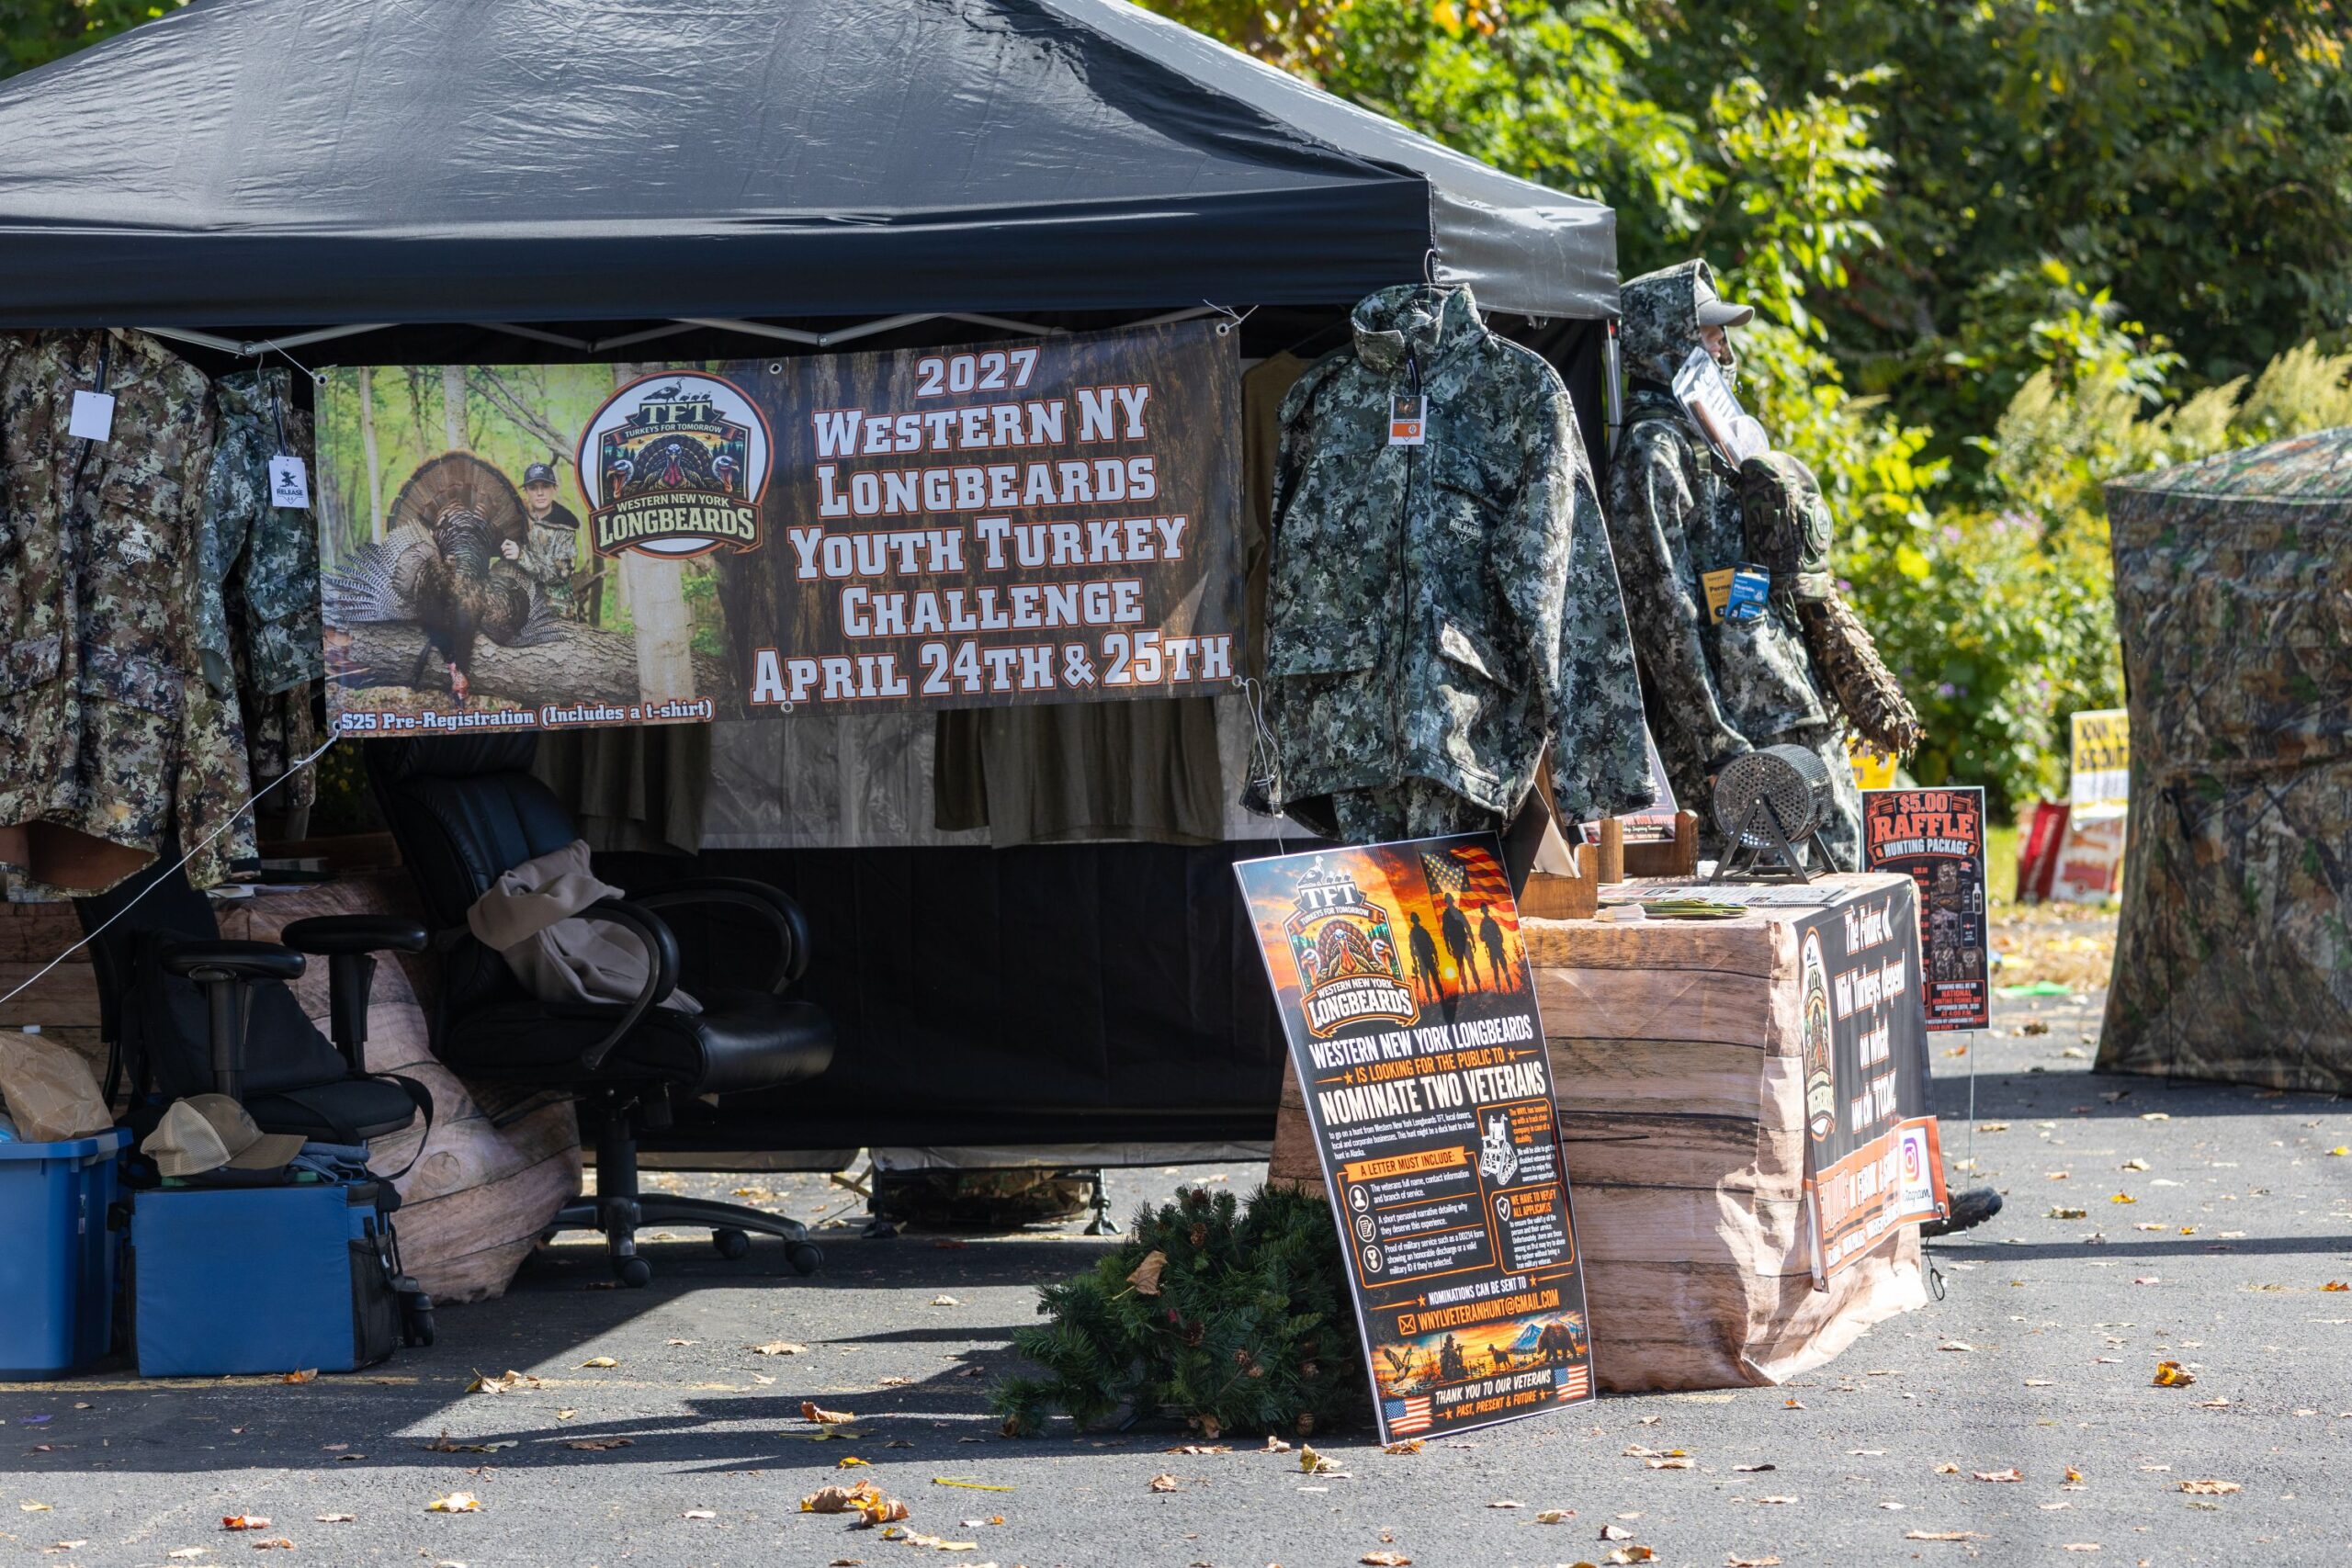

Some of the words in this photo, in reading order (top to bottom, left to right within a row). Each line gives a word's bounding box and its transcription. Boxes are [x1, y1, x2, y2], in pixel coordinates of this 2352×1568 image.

[917, 348, 1038, 396] 2027
[641, 401, 711, 424] TFT
[1078, 386, 1151, 443] NY
[625, 425, 660, 438] TURKEYS
[661, 423, 675, 432] FOR
[678, 423, 723, 434] TOMORROW
[277, 488, 304, 496] RELEASE
[616, 494, 669, 513] WESTERN
[671, 493, 696, 504] NEW
[699, 493, 730, 508] YORK
[598, 507, 755, 547] LONGBEARDS
[1449, 519, 1482, 537] RELEASE
[1063, 643, 1095, 687] &
[341, 712, 377, 731] $25
[382, 709, 535, 731] Pre-Registration
[541, 704, 625, 727] (Includes
[630, 707, 641, 719] a
[646, 698, 713, 722] t-shirt)
[1899, 793, 1948, 814] $5.00
[1873, 813, 1974, 843] RAFFLE
[1883, 839, 1925, 858] HUNTING
[1927, 839, 1968, 855] PACKAGE
[1301, 885, 1356, 909] TFT
[1301, 908, 1324, 925] TURKEYS
[1324, 907, 1335, 917] FOR
[1335, 906, 1370, 918] TOMORROW
[1316, 980, 1352, 999] WESTERN
[1351, 978, 1371, 989] NEW
[1370, 978, 1394, 989] YORK
[1307, 988, 1414, 1028] LONGBEARDS
[1308, 1035, 1379, 1069] WESTERN
[1378, 1030, 1413, 1059] NEW
[1413, 1024, 1453, 1054] YORK
[1452, 1014, 1533, 1049] LONGBEARDS
[1354, 1066, 1368, 1084] IS
[1369, 1059, 1414, 1082] LOOKING
[1414, 1057, 1436, 1075] FOR
[1435, 1054, 1456, 1071] THE
[1456, 1048, 1492, 1068] PUBLIC
[1491, 1047, 1506, 1064] TO
[1317, 1078, 1422, 1126] NOMINATE
[1419, 1072, 1464, 1111] TWO
[1463, 1061, 1546, 1104] VETERANS
[1329, 1132, 1335, 1140] to
[1335, 1132, 1341, 1140] go
[1351, 1127, 1363, 1135] hunt
[1363, 1125, 1374, 1134] from
[1374, 1123, 1393, 1132] Western
[1392, 1121, 1403, 1129] New
[1402, 1119, 1413, 1128] York
[1412, 1115, 1437, 1127] Longbeards
[1445, 1111, 1456, 1121] local
[1333, 1151, 1345, 1160] hunt
[1344, 1150, 1350, 1158] in
[1360, 1165, 1367, 1177] A
[1367, 1161, 1396, 1177] LETTER
[1397, 1156, 1419, 1170] MUST
[1420, 1151, 1456, 1168] INCLUDE:
[1370, 1183, 1381, 1192] The
[1381, 1180, 1402, 1191] veterans
[1401, 1179, 1410, 1188] full
[1410, 1179, 1425, 1187] name,
[1425, 1174, 1443, 1184] contact
[1442, 1169, 1470, 1181] information
[1374, 1194, 1384, 1204] and
[1383, 1191, 1401, 1202] branch
[1400, 1190, 1407, 1199] of
[1406, 1189, 1426, 1199] service.
[1510, 1194, 1520, 1205] WE
[1519, 1192, 1533, 1204] HAVE
[1533, 1190, 1540, 1201] TO
[1378, 1215, 1384, 1224] A
[1383, 1213, 1396, 1224] short
[1396, 1211, 1417, 1223] personal
[1416, 1208, 1438, 1218] narrative
[1438, 1204, 1458, 1214] detailing
[1458, 1202, 1468, 1213] why
[1513, 1206, 1523, 1218] ALL
[1380, 1226, 1392, 1235] they
[1392, 1224, 1411, 1234] deserve
[1410, 1221, 1421, 1231] this
[1420, 1218, 1448, 1230] experience.
[1384, 1244, 1398, 1254] Proof
[1397, 1242, 1404, 1251] of
[1403, 1240, 1421, 1250] military
[1420, 1238, 1438, 1247] service
[1438, 1235, 1449, 1245] such
[1449, 1235, 1455, 1243] as
[1473, 1230, 1485, 1239] form
[1386, 1254, 1408, 1265] showing
[1407, 1253, 1414, 1261] an
[1413, 1248, 1436, 1260] honorable
[1435, 1245, 1457, 1256] discharge
[1456, 1244, 1463, 1252] or
[1465, 1241, 1477, 1250] valid
[1389, 1264, 1408, 1275] military
[1407, 1263, 1413, 1272] ID
[1413, 1262, 1418, 1271] if
[1428, 1285, 1475, 1305] NOMINATIONS
[1475, 1282, 1490, 1298] CAN
[1490, 1280, 1500, 1294] BE
[1499, 1278, 1517, 1293] SENT
[1517, 1276, 1527, 1290] TO
[1417, 1289, 1560, 1331] WNYLVETERANHUNT@GMAIL.COM
[1435, 1387, 1463, 1405] THANK
[1464, 1383, 1481, 1400] YOU
[1483, 1381, 1493, 1396] TO
[1495, 1377, 1511, 1393] OUR
[1513, 1369, 1552, 1391] VETERANS
[1476, 1396, 1505, 1414] PRESENT
[1506, 1395, 1511, 1407] &
[1513, 1390, 1537, 1406] FUTURE
